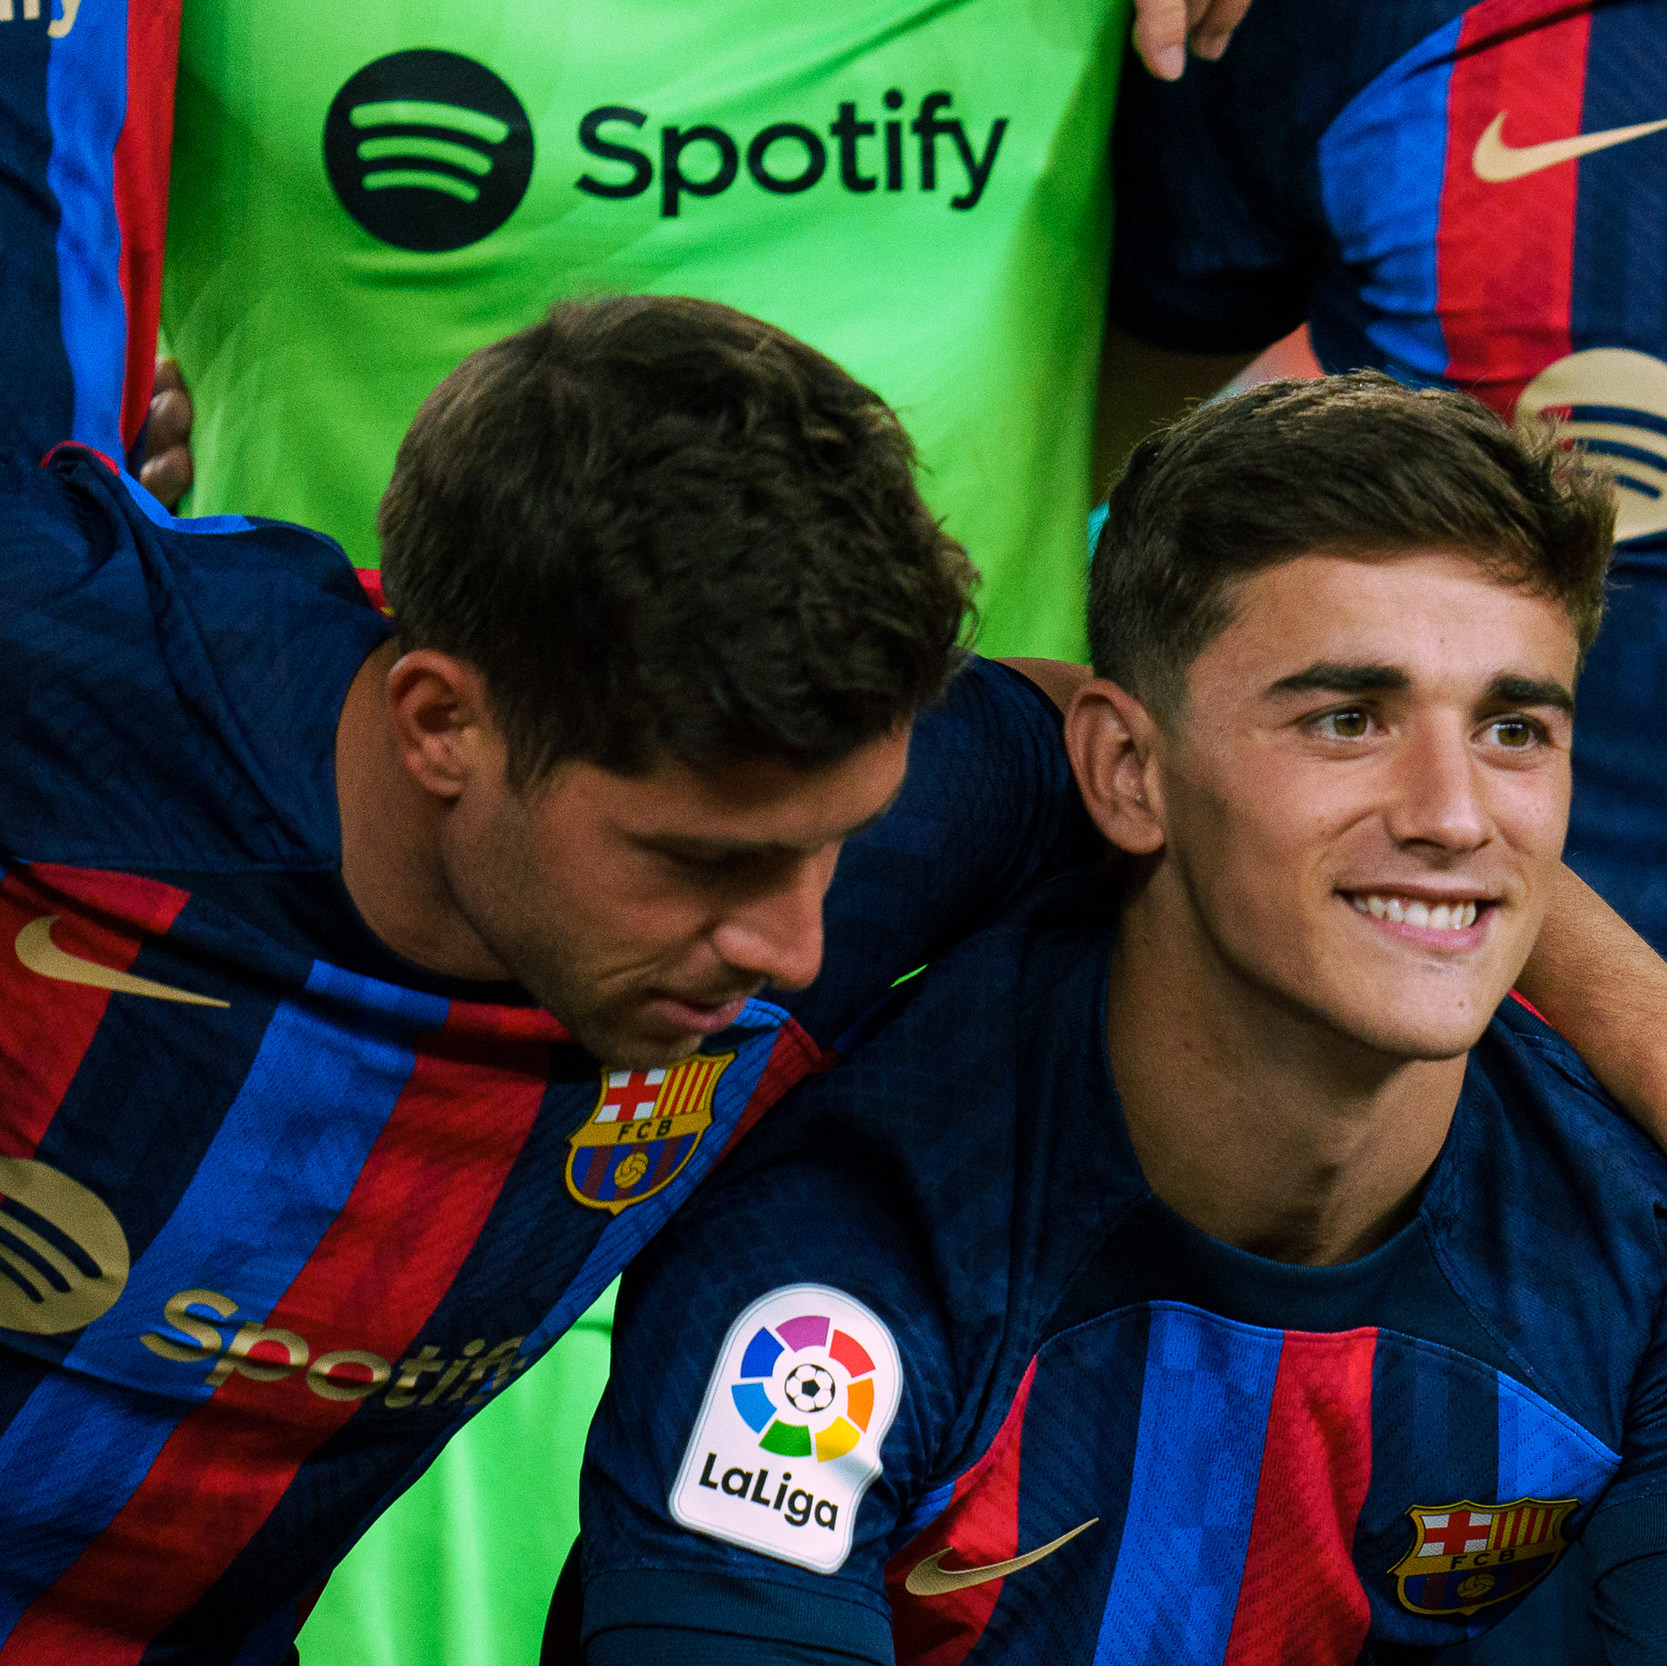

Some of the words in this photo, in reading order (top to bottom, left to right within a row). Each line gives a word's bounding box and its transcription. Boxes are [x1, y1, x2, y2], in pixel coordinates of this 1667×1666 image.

[574, 88, 1009, 218] Spotify
[617, 1119, 672, 1142] FCB
[698, 1452, 839, 1532] LaLiga
[1450, 1549, 1516, 1570] FCB
